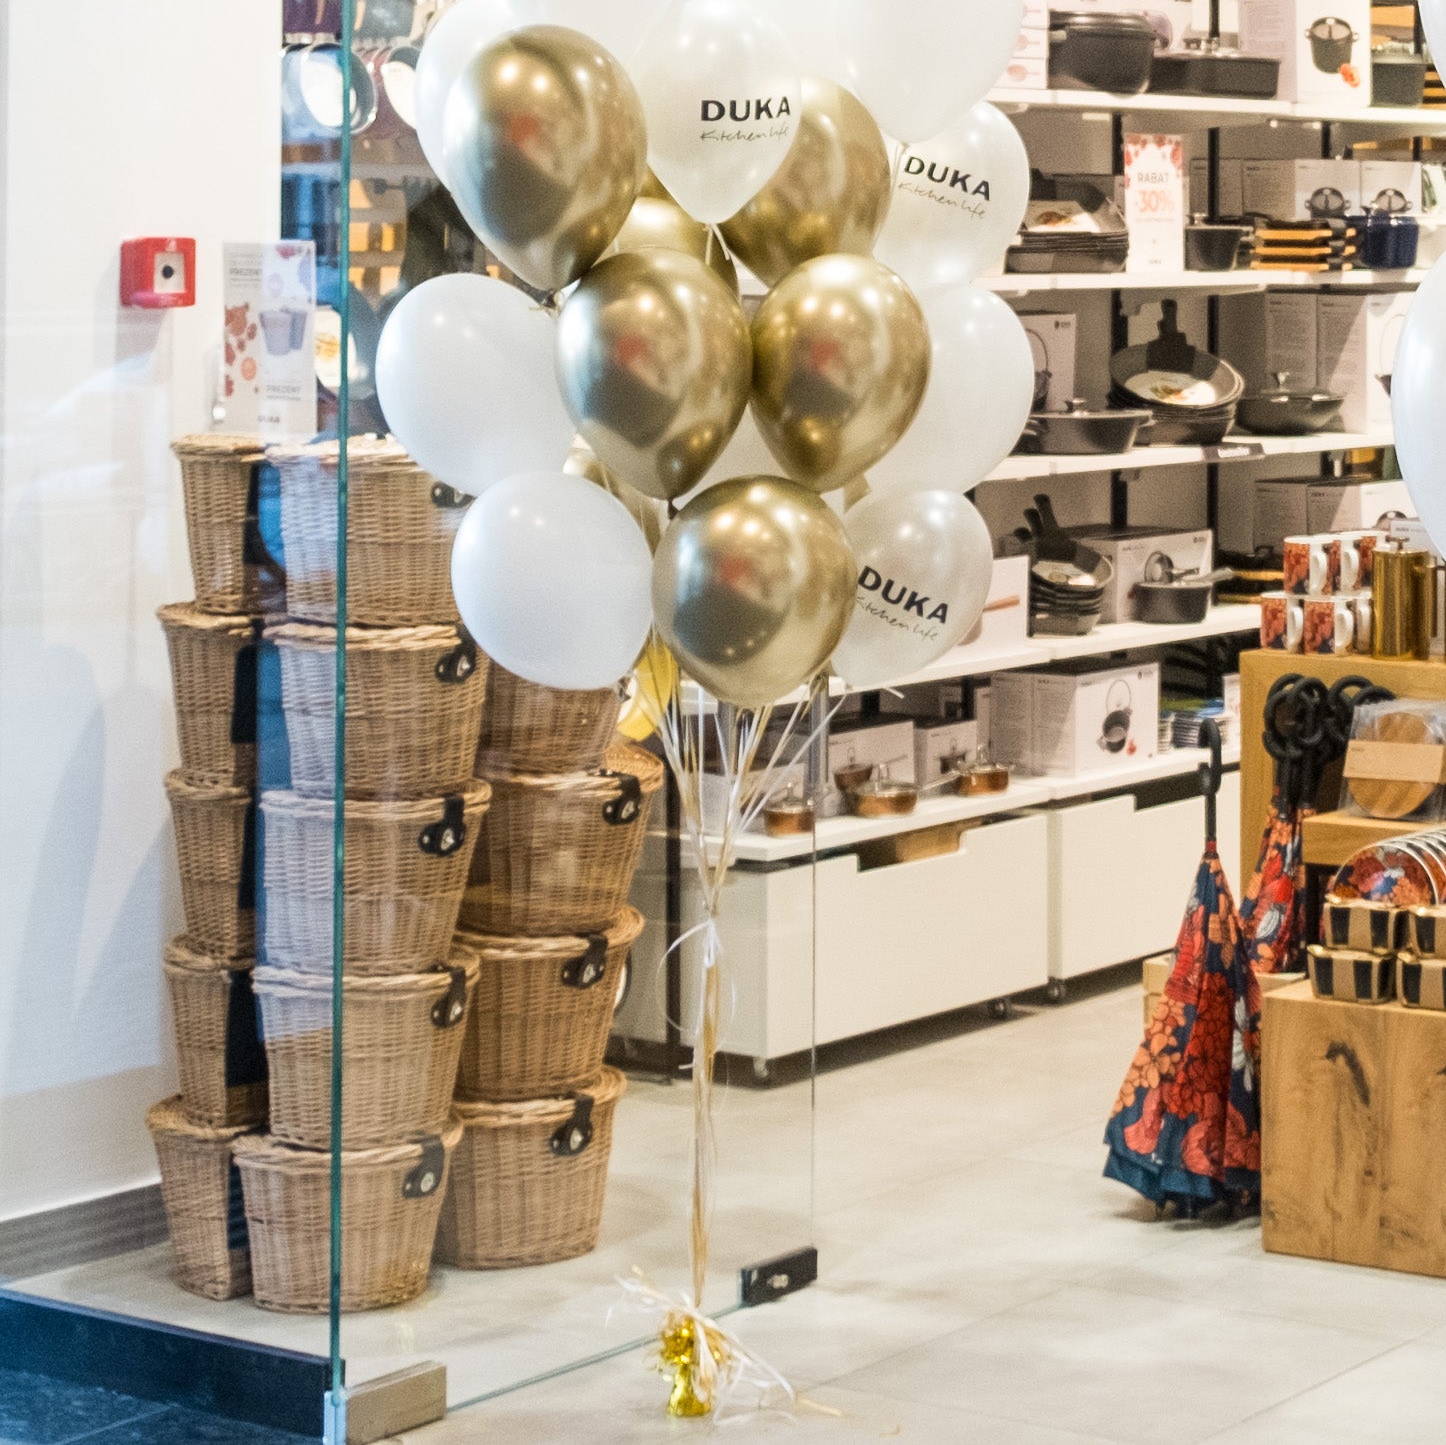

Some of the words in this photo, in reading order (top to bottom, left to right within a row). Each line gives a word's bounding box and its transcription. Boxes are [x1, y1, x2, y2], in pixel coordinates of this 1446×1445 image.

[701, 96, 791, 122] DUKA
[904, 156, 990, 202] DUKA
[858, 565, 948, 624] DUKA
